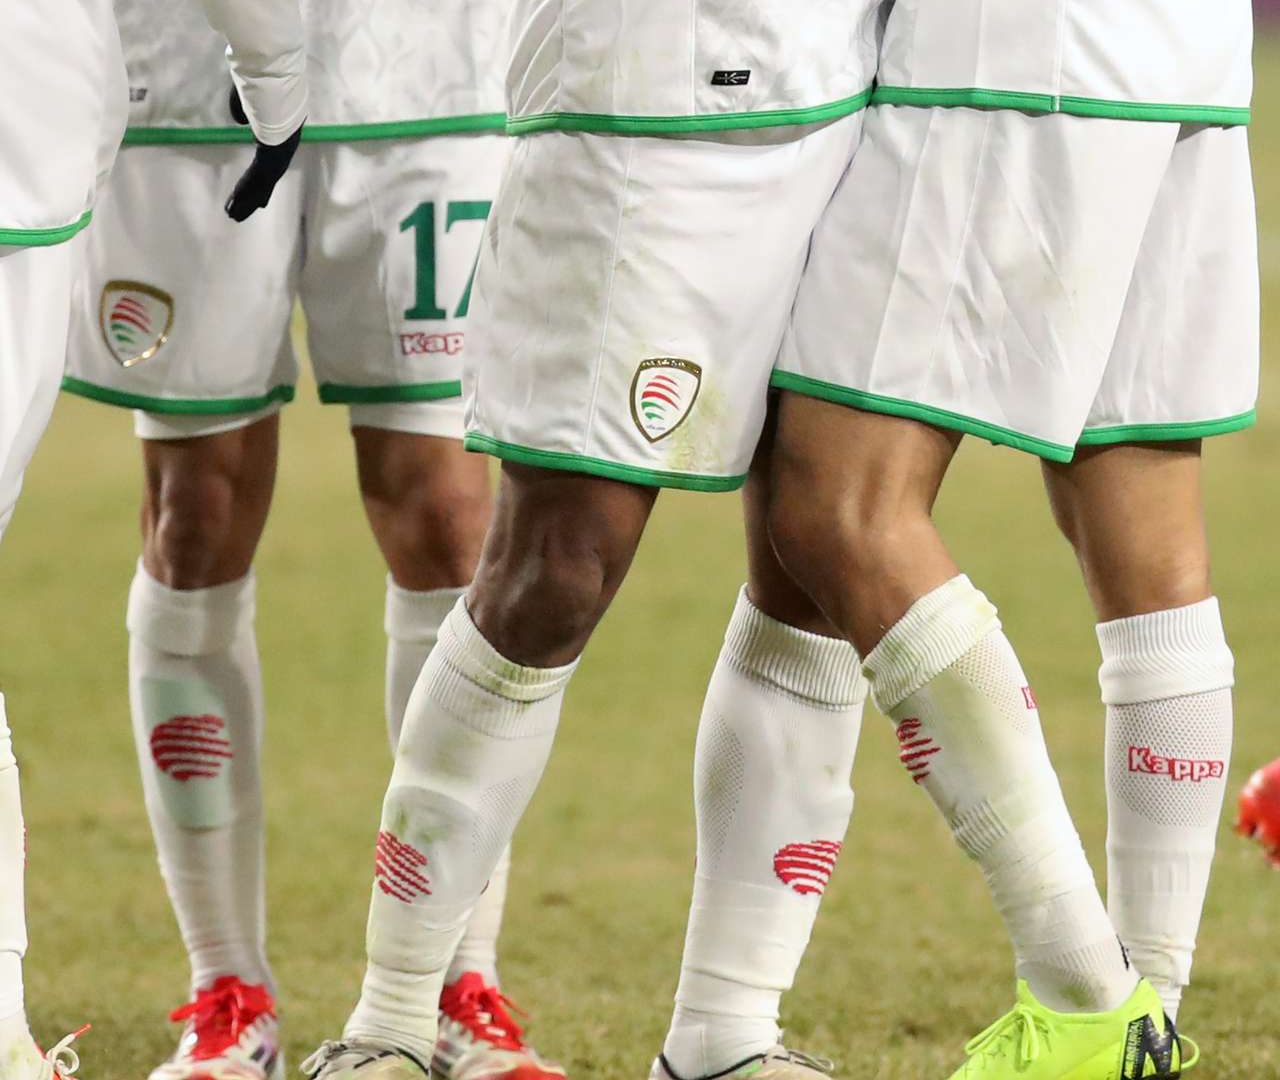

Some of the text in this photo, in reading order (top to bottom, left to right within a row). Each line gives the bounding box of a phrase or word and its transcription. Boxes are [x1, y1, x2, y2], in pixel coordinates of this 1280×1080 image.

[399, 201, 493, 320] 17
[399, 333, 465, 356] Kap
[1128, 746, 1224, 782] Kappa
